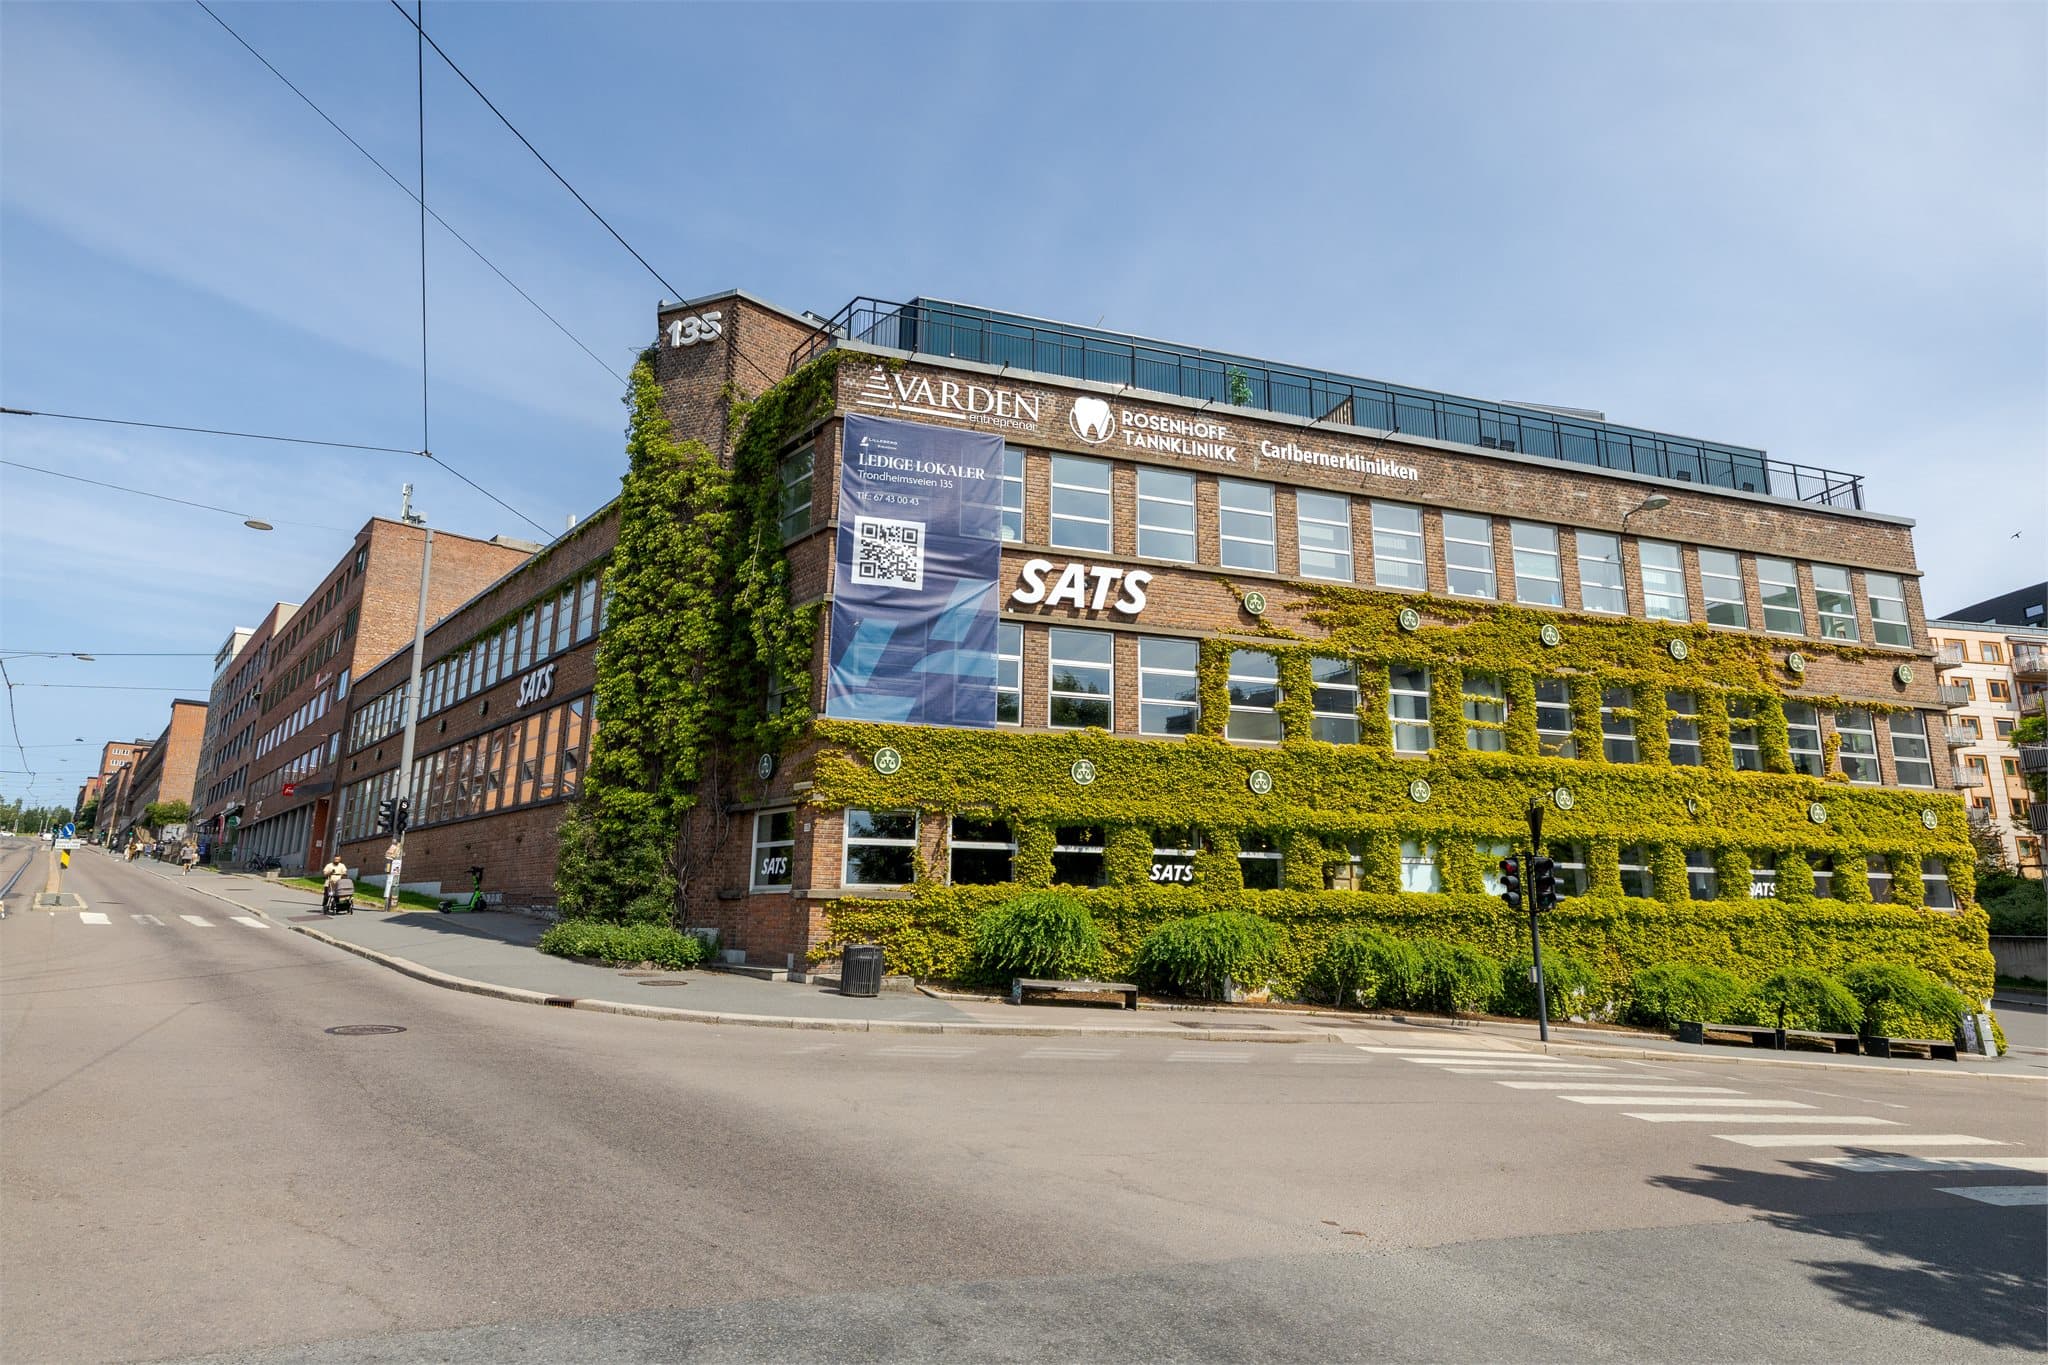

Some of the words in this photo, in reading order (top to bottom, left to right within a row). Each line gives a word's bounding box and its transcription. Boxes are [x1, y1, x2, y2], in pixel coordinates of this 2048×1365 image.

[667, 311, 722, 347] 135
[891, 373, 1041, 421] VARDEN
[969, 414, 1038, 431] entreprenør
[1122, 411, 1227, 440] ROSENHOFF
[1122, 430, 1237, 462] TANNKLINIKK
[1261, 440, 1418, 480] Carlbernerklinikken
[858, 453, 913, 472] LEDIGE
[916, 460, 985, 480] LOKALER
[858, 469, 937, 487] Trondheimsveien
[940, 479, 953, 489] 135
[873, 493, 884, 502] 67
[885, 494, 896, 503] 43
[897, 496, 908, 505] 00
[909, 497, 919, 506] 43
[1011, 558, 1153, 614] SATS
[516, 663, 555, 708] SATS
[761, 857, 788, 875] SATS
[1149, 863, 1194, 881] SATS
